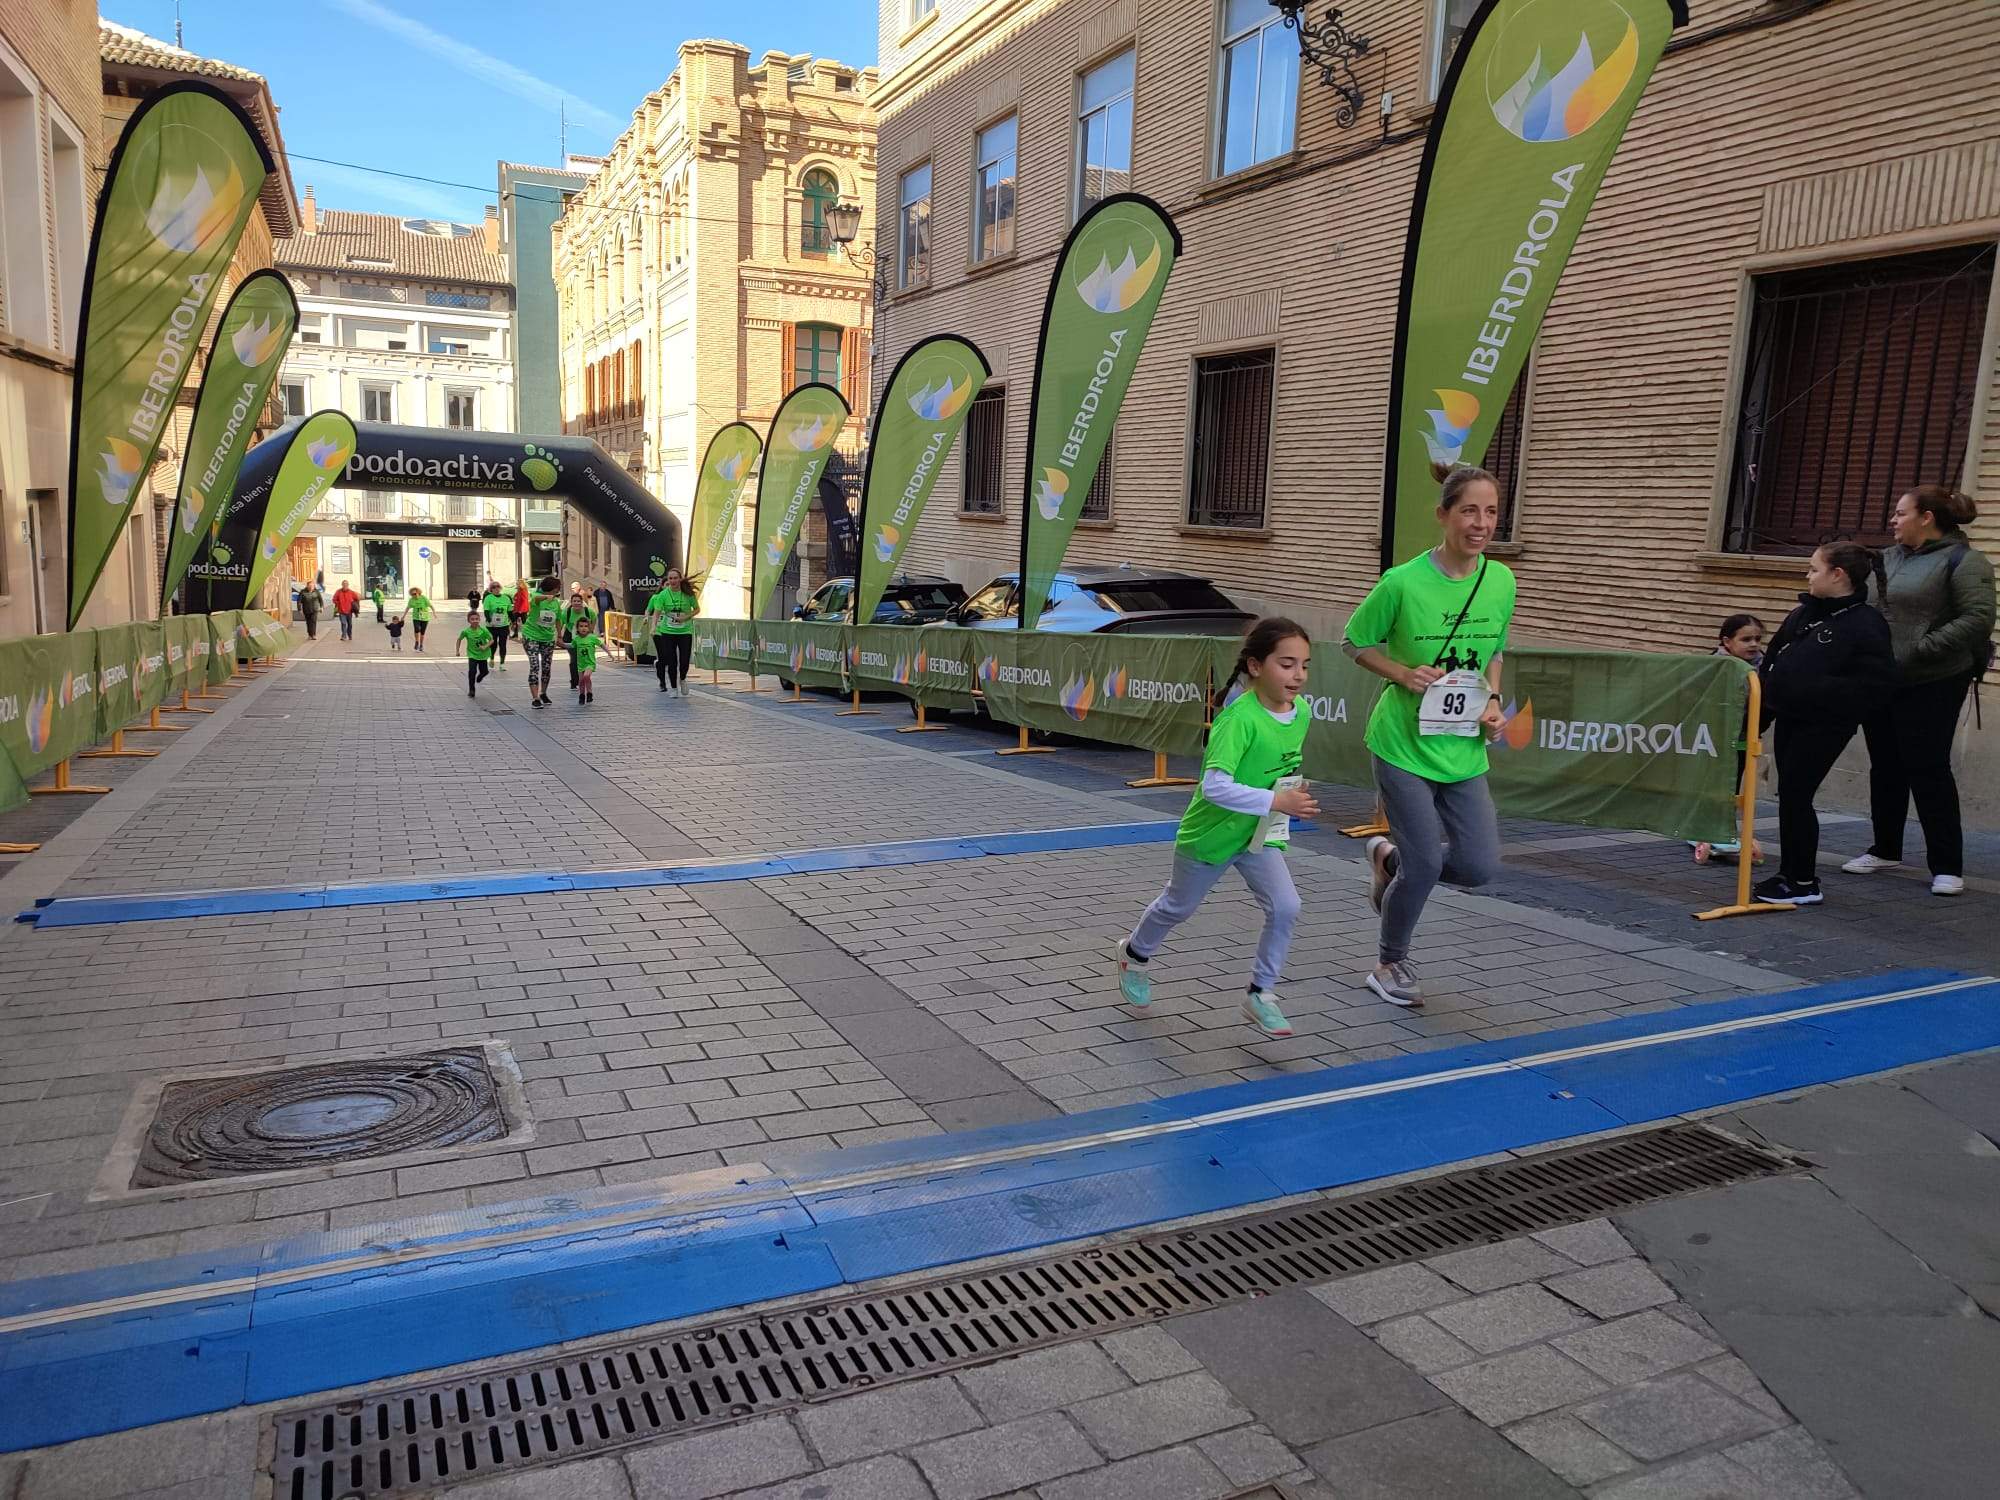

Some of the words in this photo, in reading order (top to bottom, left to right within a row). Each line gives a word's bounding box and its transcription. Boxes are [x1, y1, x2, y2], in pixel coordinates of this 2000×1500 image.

[1461, 162, 1585, 385] IBERDROLA
[128, 272, 210, 442] IBERDROLA
[1058, 328, 1128, 468] IBERDROLA
[200, 382, 258, 493] IBERDROLA
[346, 450, 515, 482] podoactiva
[891, 431, 947, 527] IBERDROLA
[241, 486, 268, 503] bien,
[278, 475, 326, 537] IBERDROLA
[583, 466, 601, 485] Pisa
[600, 481, 618, 503] bien,
[619, 500, 634, 515] vive
[633, 513, 657, 534] mejor
[779, 459, 820, 537] IBERDROLA
[448, 528, 482, 538] INSIDE
[187, 562, 249, 578] podoactiv
[628, 576, 663, 591] podoa
[998, 666, 1052, 687] IBERDROLA
[1128, 678, 1202, 704] IBERDROLA
[1304, 694, 1348, 723] ROLA
[1442, 692, 1466, 715] 93
[1539, 718, 1719, 757] IBERDROLA
